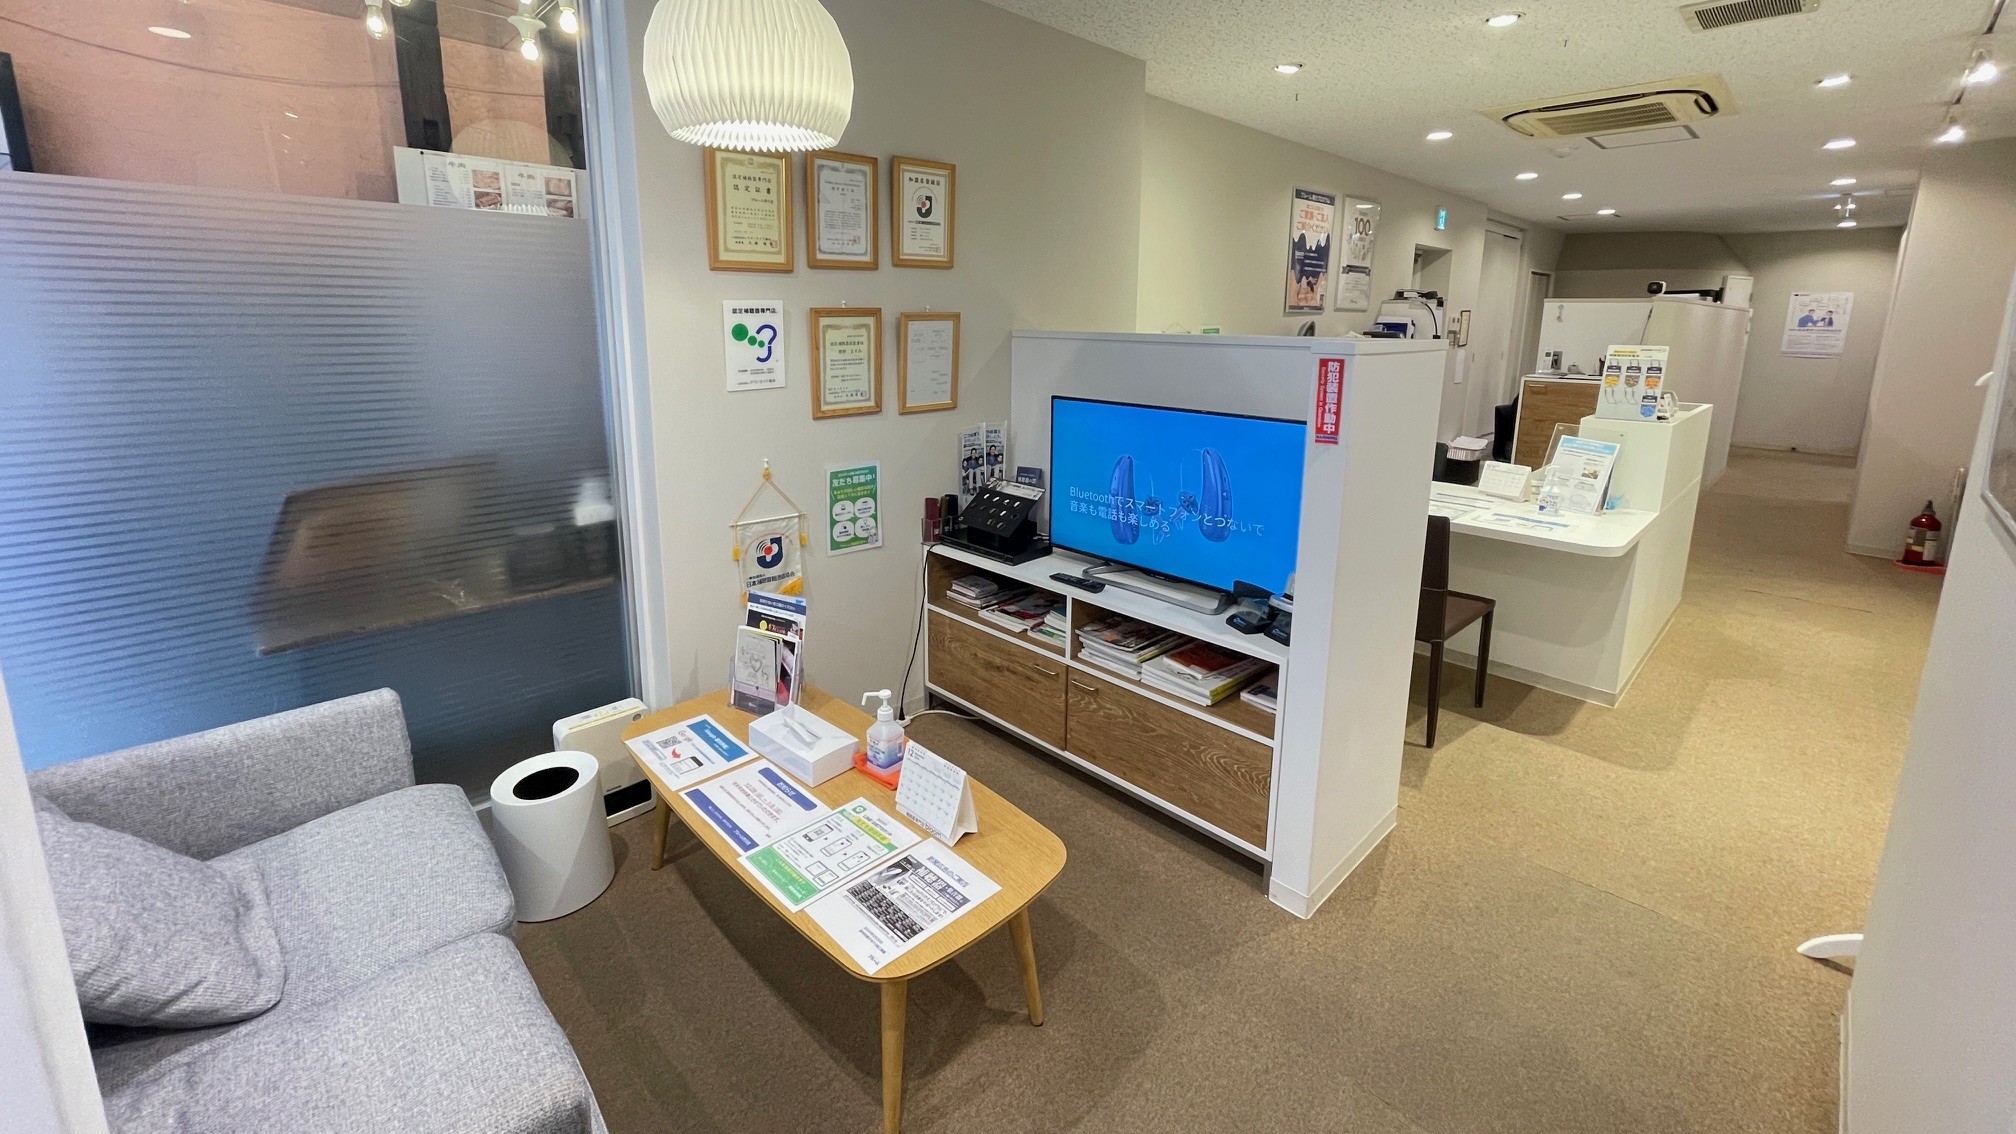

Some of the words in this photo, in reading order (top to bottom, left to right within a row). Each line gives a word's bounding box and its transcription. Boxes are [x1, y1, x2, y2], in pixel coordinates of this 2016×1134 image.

[1355, 217, 1371, 237] 100
[732, 307, 777, 315] 認定補聴器専門店
[1323, 361, 1340, 434] 防犯装置作動中
[1069, 486, 1264, 536] Bluetoothでスマートフォンとつないで
[1069, 500, 1171, 532] 音楽も電話も楽しめる
[907, 748, 914, 757] 12
